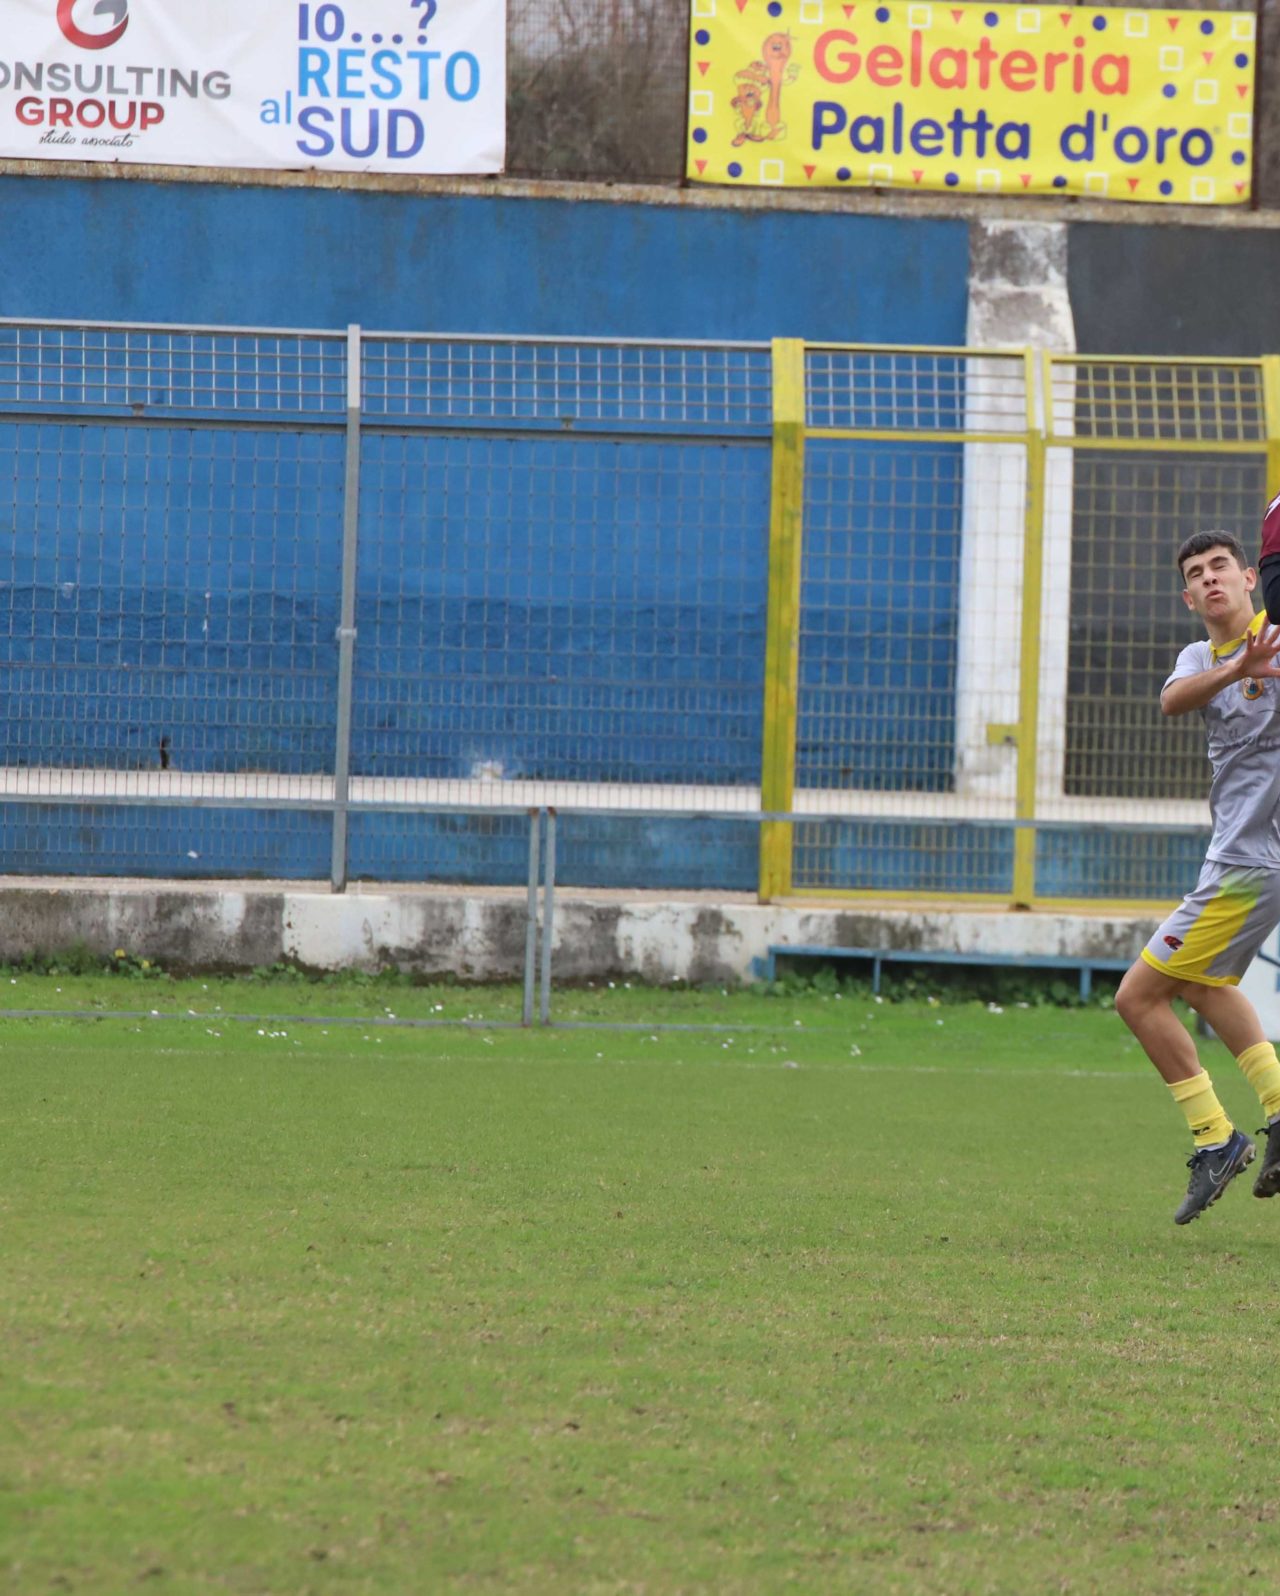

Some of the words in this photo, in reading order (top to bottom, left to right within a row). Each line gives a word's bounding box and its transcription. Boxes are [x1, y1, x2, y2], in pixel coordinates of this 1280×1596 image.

[298, 46, 481, 102] RESTO
[812, 29, 1131, 96] Gelateria
[15, 96, 165, 130] GROUP
[39, 128, 77, 145] studio
[80, 132, 140, 148] associato
[259, 90, 292, 125] al
[296, 106, 425, 158] SUD
[810, 100, 1032, 159] Paletta
[1058, 109, 1215, 167] d'oro
